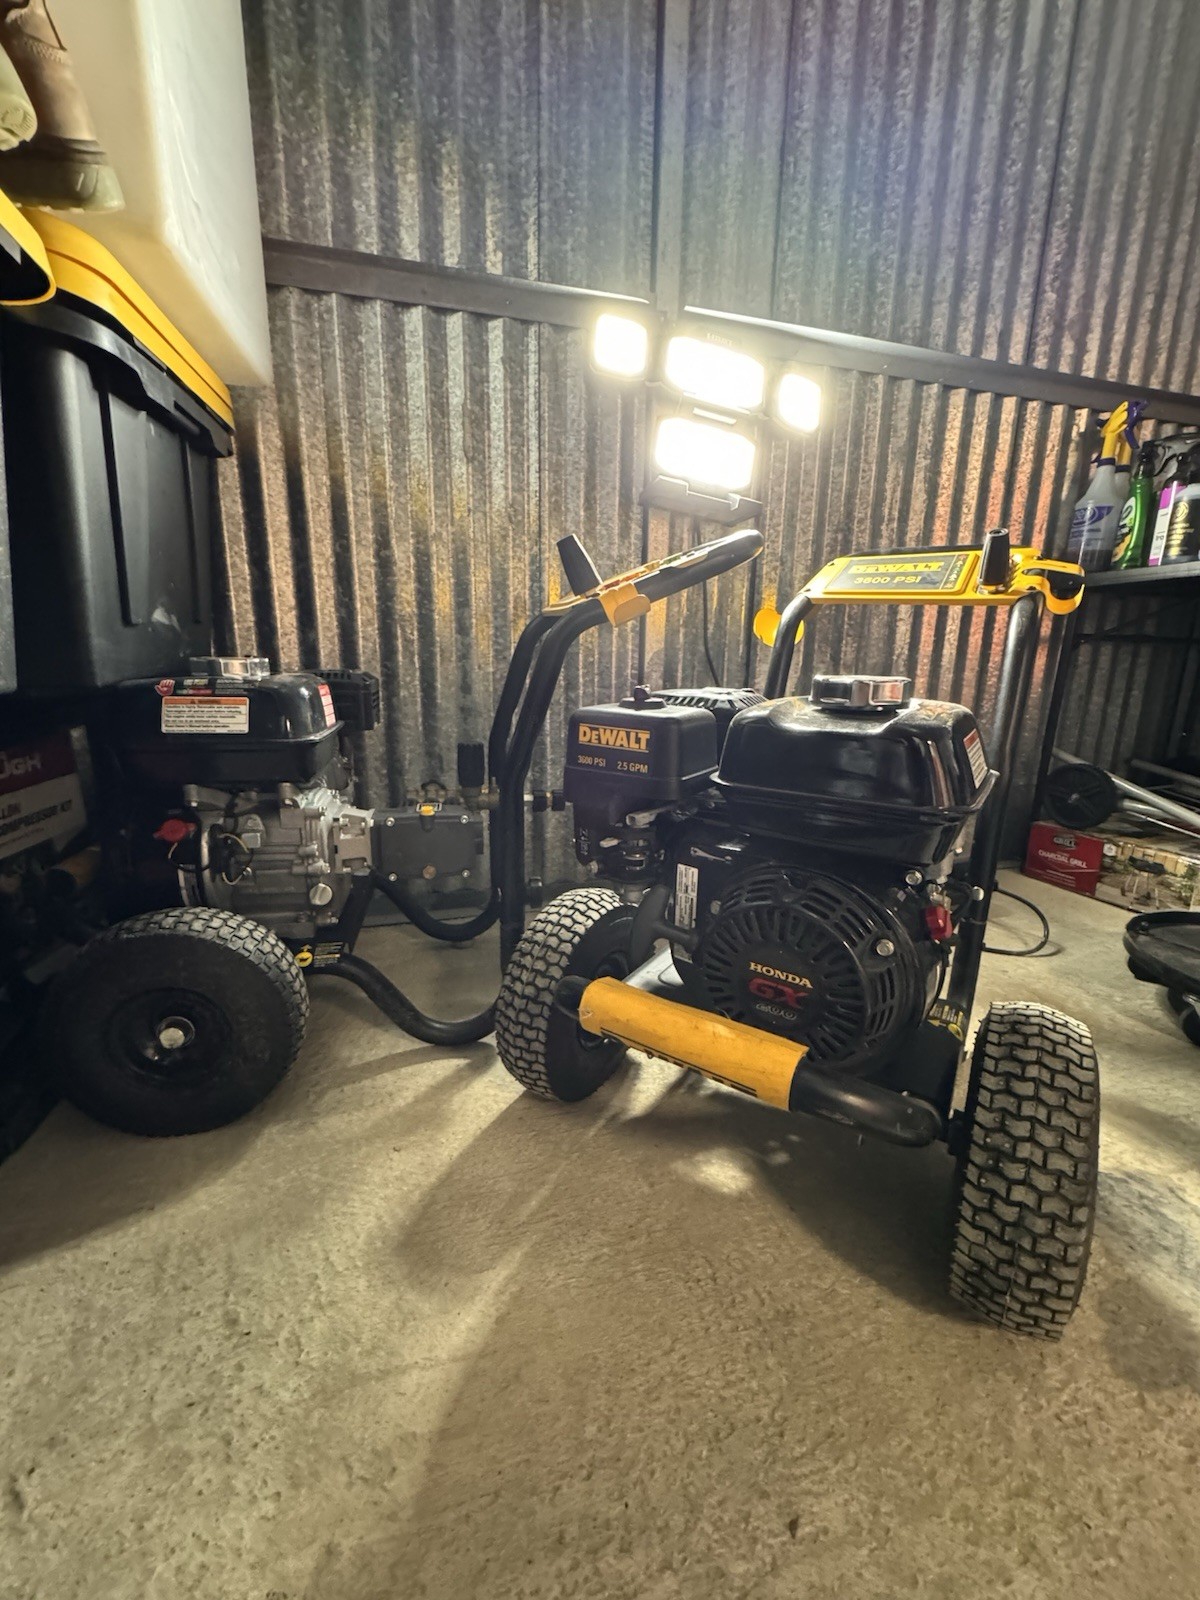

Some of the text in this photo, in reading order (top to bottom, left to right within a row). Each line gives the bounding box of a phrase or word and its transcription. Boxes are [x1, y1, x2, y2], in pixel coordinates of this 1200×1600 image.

[892, 575, 922, 584] PSI
[577, 754, 607, 768] 3600 PSI
[629, 762, 649, 774] GPM
[748, 961, 814, 989] HONDA
[748, 977, 810, 1009] GX
